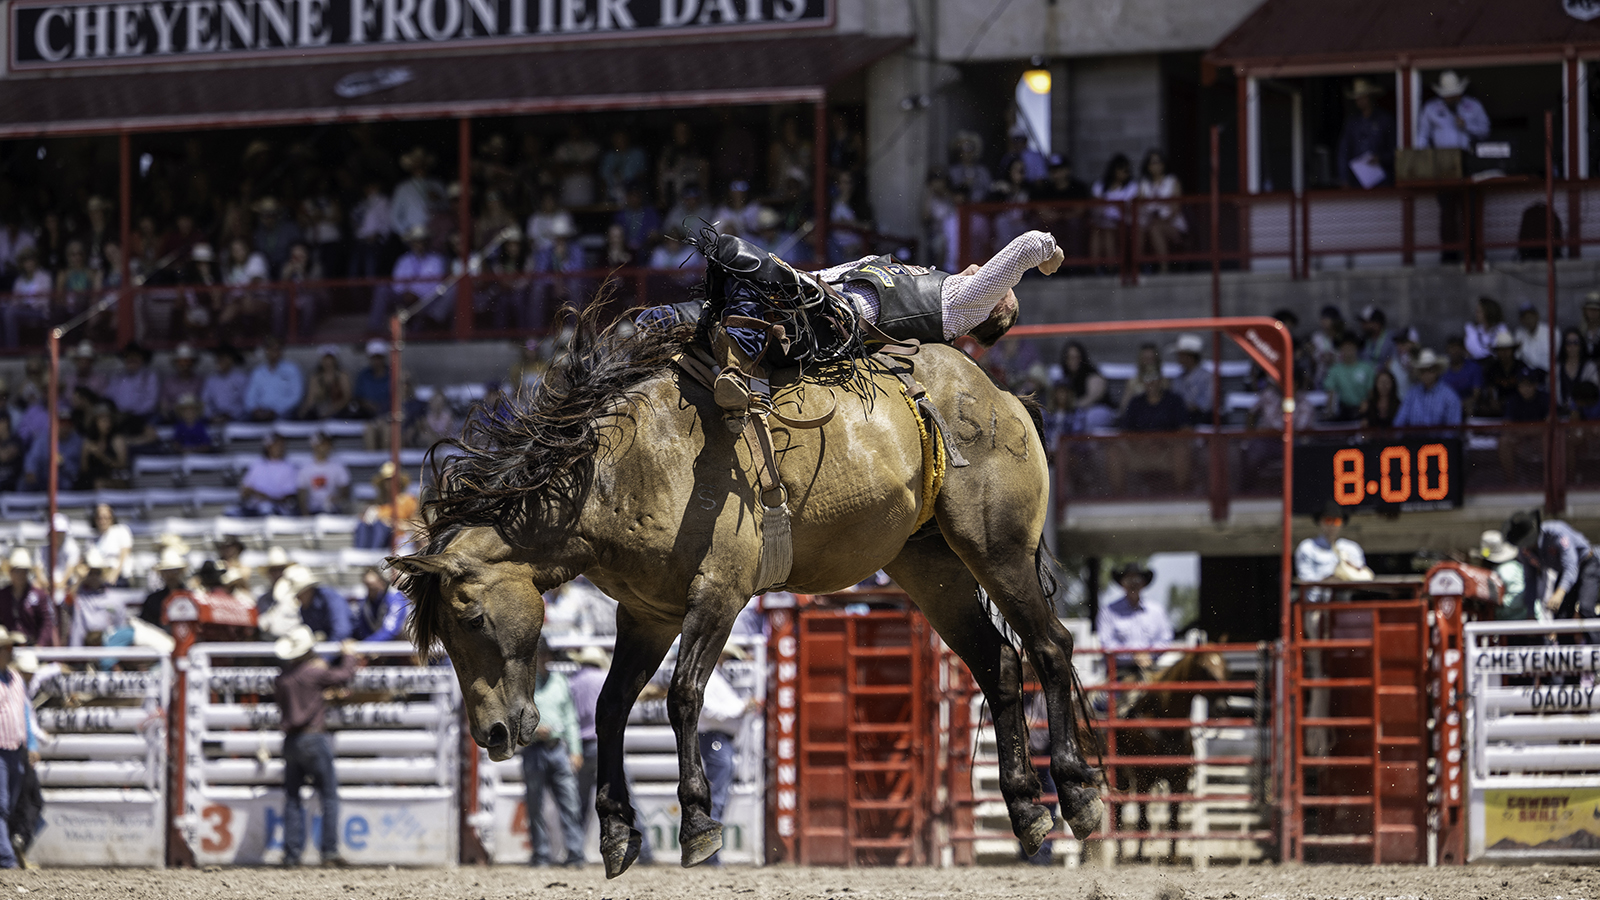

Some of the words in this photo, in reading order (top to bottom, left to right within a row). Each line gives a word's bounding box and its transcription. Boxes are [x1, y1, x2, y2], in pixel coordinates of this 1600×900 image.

[34, 0, 332, 61] CHEYENNE
[350, 0, 638, 44] FRONTIER
[1333, 443, 1449, 506] 8.00
[1476, 651, 1583, 670] CHEYENNE
[777, 635, 797, 837] CHEYENNE
[202, 804, 233, 851] 3
[265, 806, 370, 851] be
